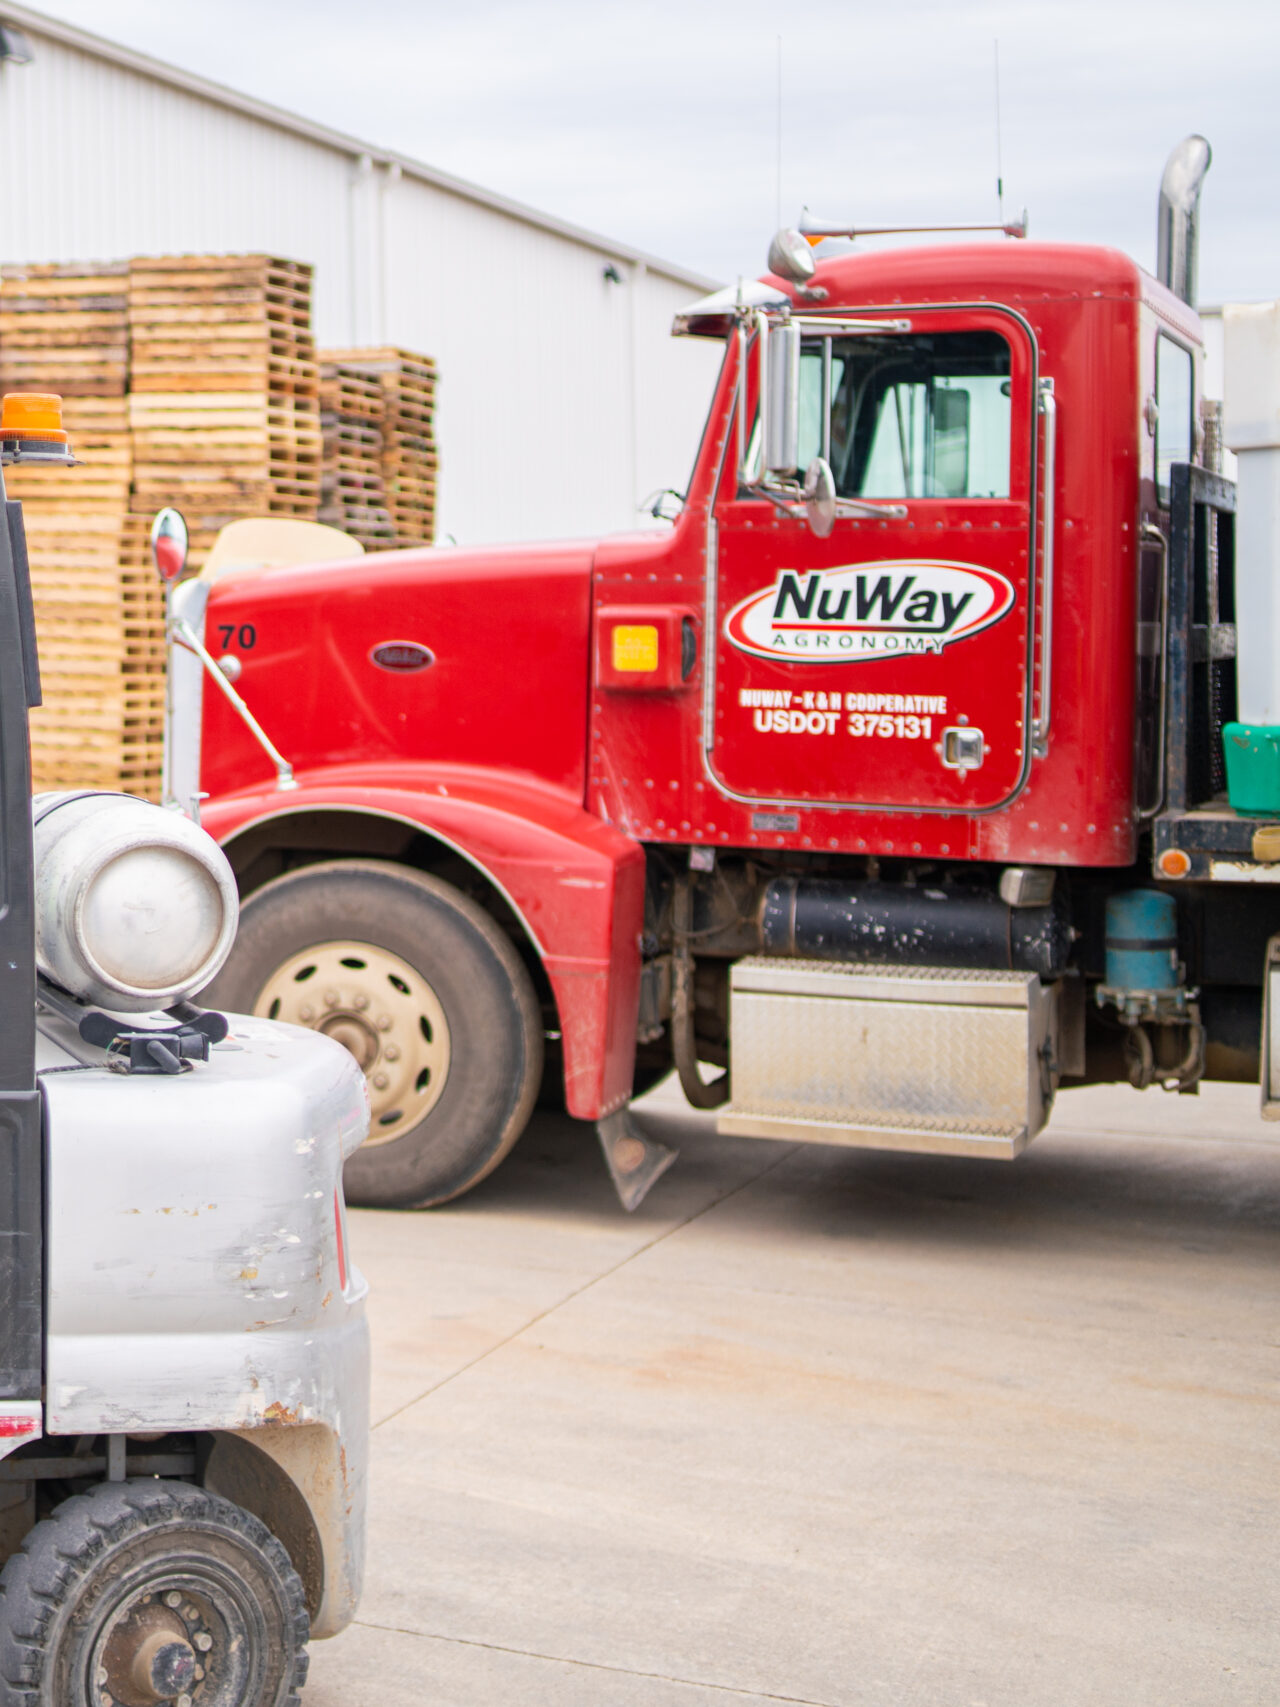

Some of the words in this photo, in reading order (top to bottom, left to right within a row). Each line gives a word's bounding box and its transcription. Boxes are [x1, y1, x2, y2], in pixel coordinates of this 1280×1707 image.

[773, 574, 975, 633] NuWay
[218, 624, 257, 650] 70
[772, 633, 945, 651] AGRONOMY
[845, 693, 947, 714] COOPERATIVE
[753, 709, 841, 735] USDOT
[847, 713, 932, 739] 375131
